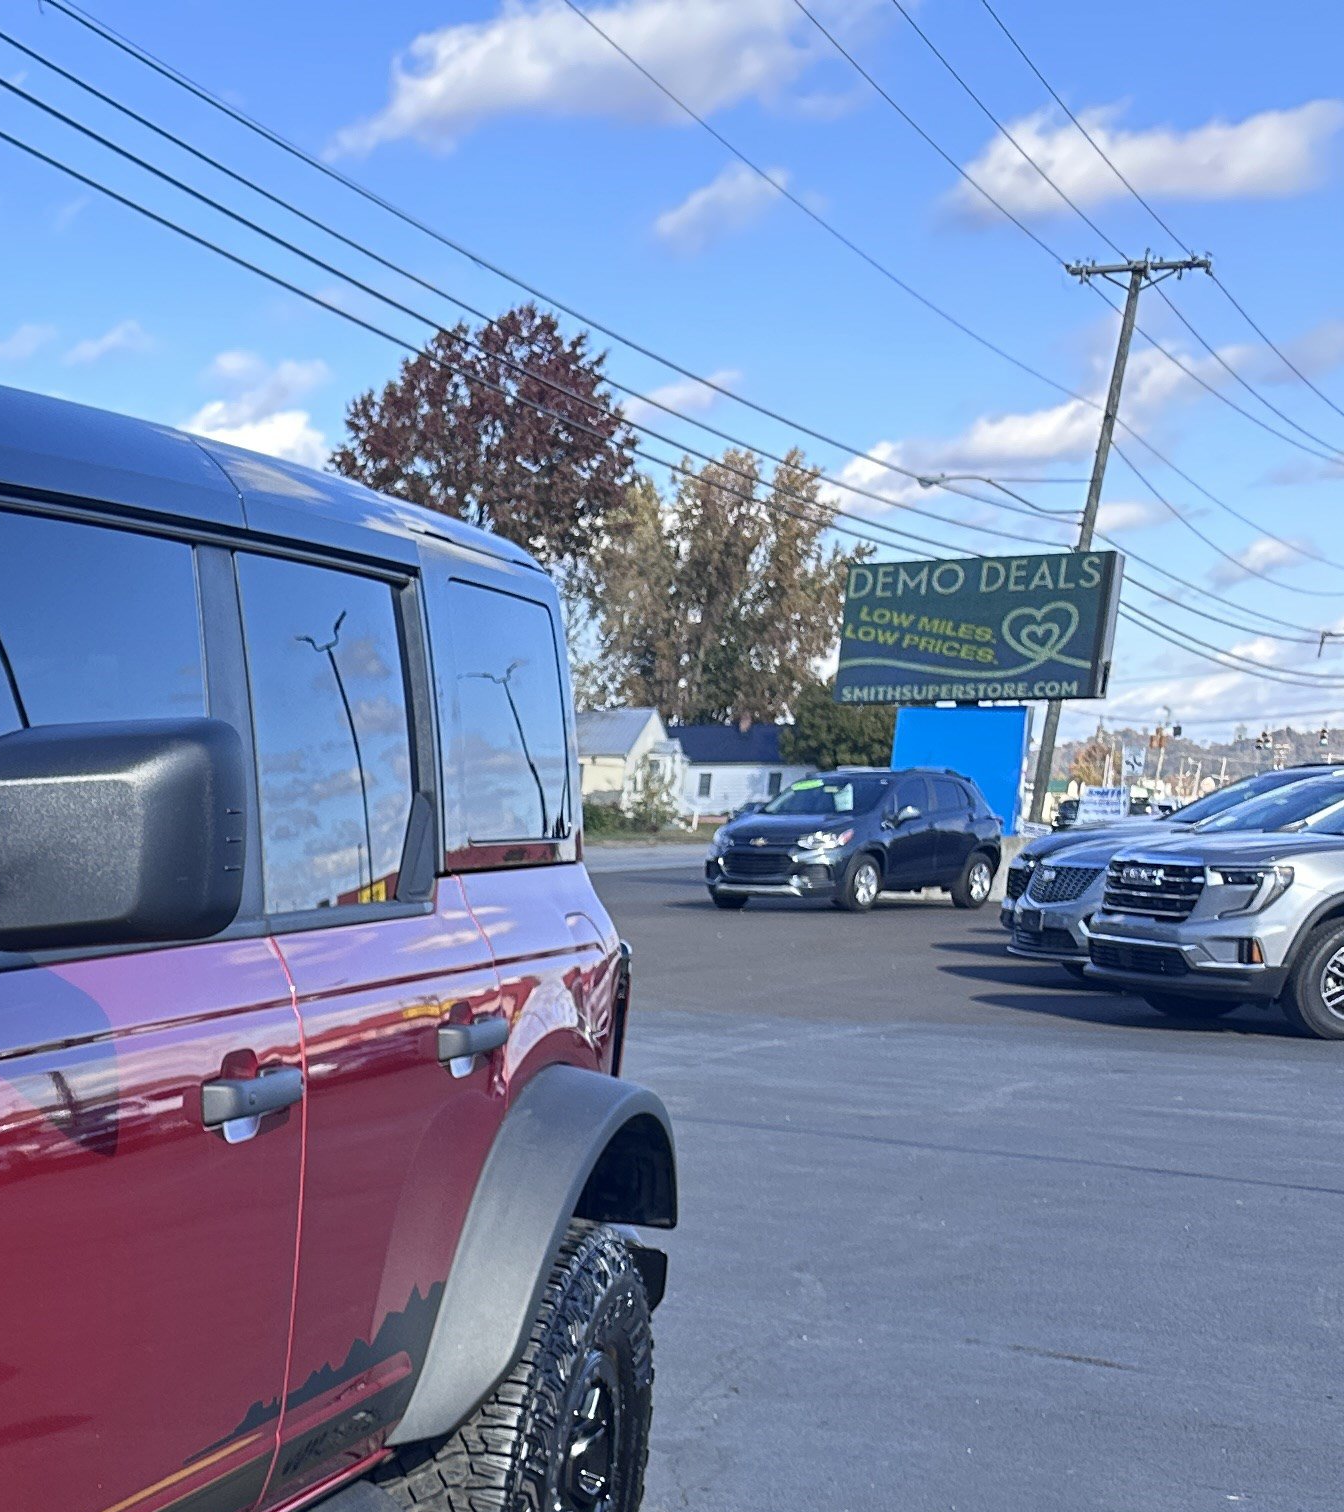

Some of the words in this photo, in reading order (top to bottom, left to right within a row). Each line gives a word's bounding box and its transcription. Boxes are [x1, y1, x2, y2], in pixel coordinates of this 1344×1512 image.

[847, 562, 965, 599] DEMO
[979, 556, 1102, 593] DEALS
[844, 623, 900, 646] LOW
[901, 634, 999, 666] PRICES.
[859, 605, 915, 628] LOW
[917, 616, 997, 644] MILES.
[841, 680, 1079, 703] SMITHSUPERSTORE.COM
